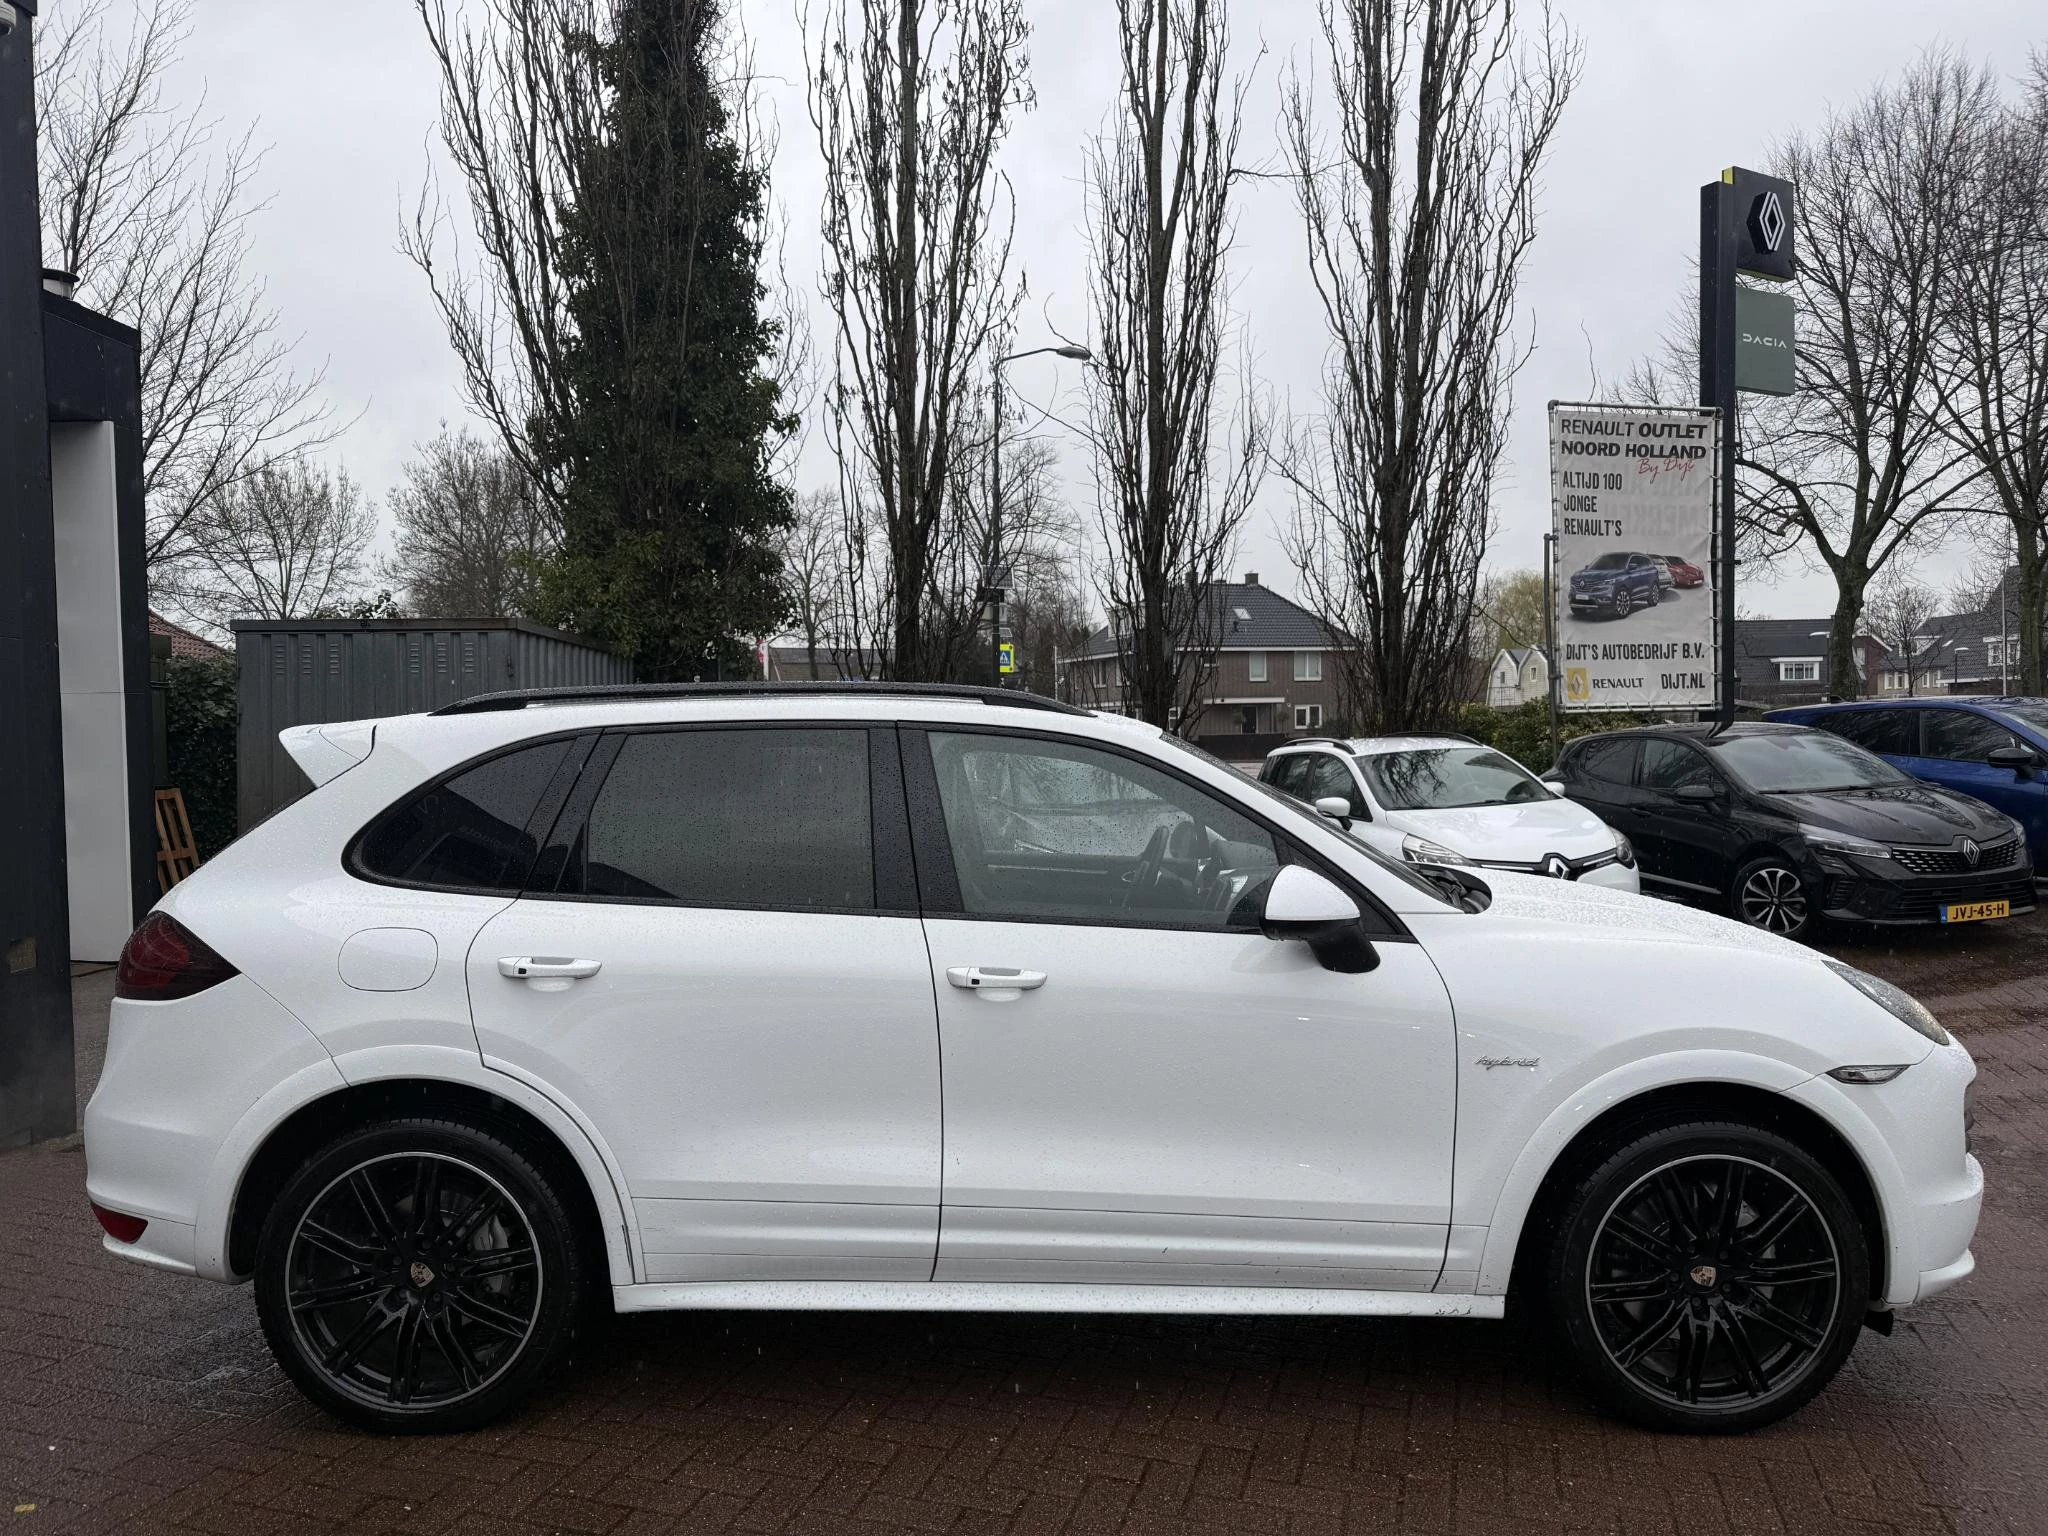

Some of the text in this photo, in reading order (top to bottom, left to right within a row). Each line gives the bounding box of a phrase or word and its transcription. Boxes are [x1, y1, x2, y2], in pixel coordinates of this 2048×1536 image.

[1742, 333, 1787, 349] DACIA
[1561, 419, 1708, 439] RENAULT OUTLET
[1561, 440, 1707, 460] NOORD HOLLAND
[1638, 458, 1660, 484] By
[1563, 471, 1599, 489] ALTIJD
[1603, 473, 1622, 490] 100
[1564, 495, 1597, 513] JONGE
[1564, 518, 1622, 537] RENAULT'S
[1566, 642, 1705, 660] DIJT'S AUTOBEDRIJF B.V.
[1592, 673, 1705, 690] RENAULT DIJT.NL
[1953, 903, 2004, 919] JVJ-45-H
[1475, 1056, 1541, 1071] hybrid
